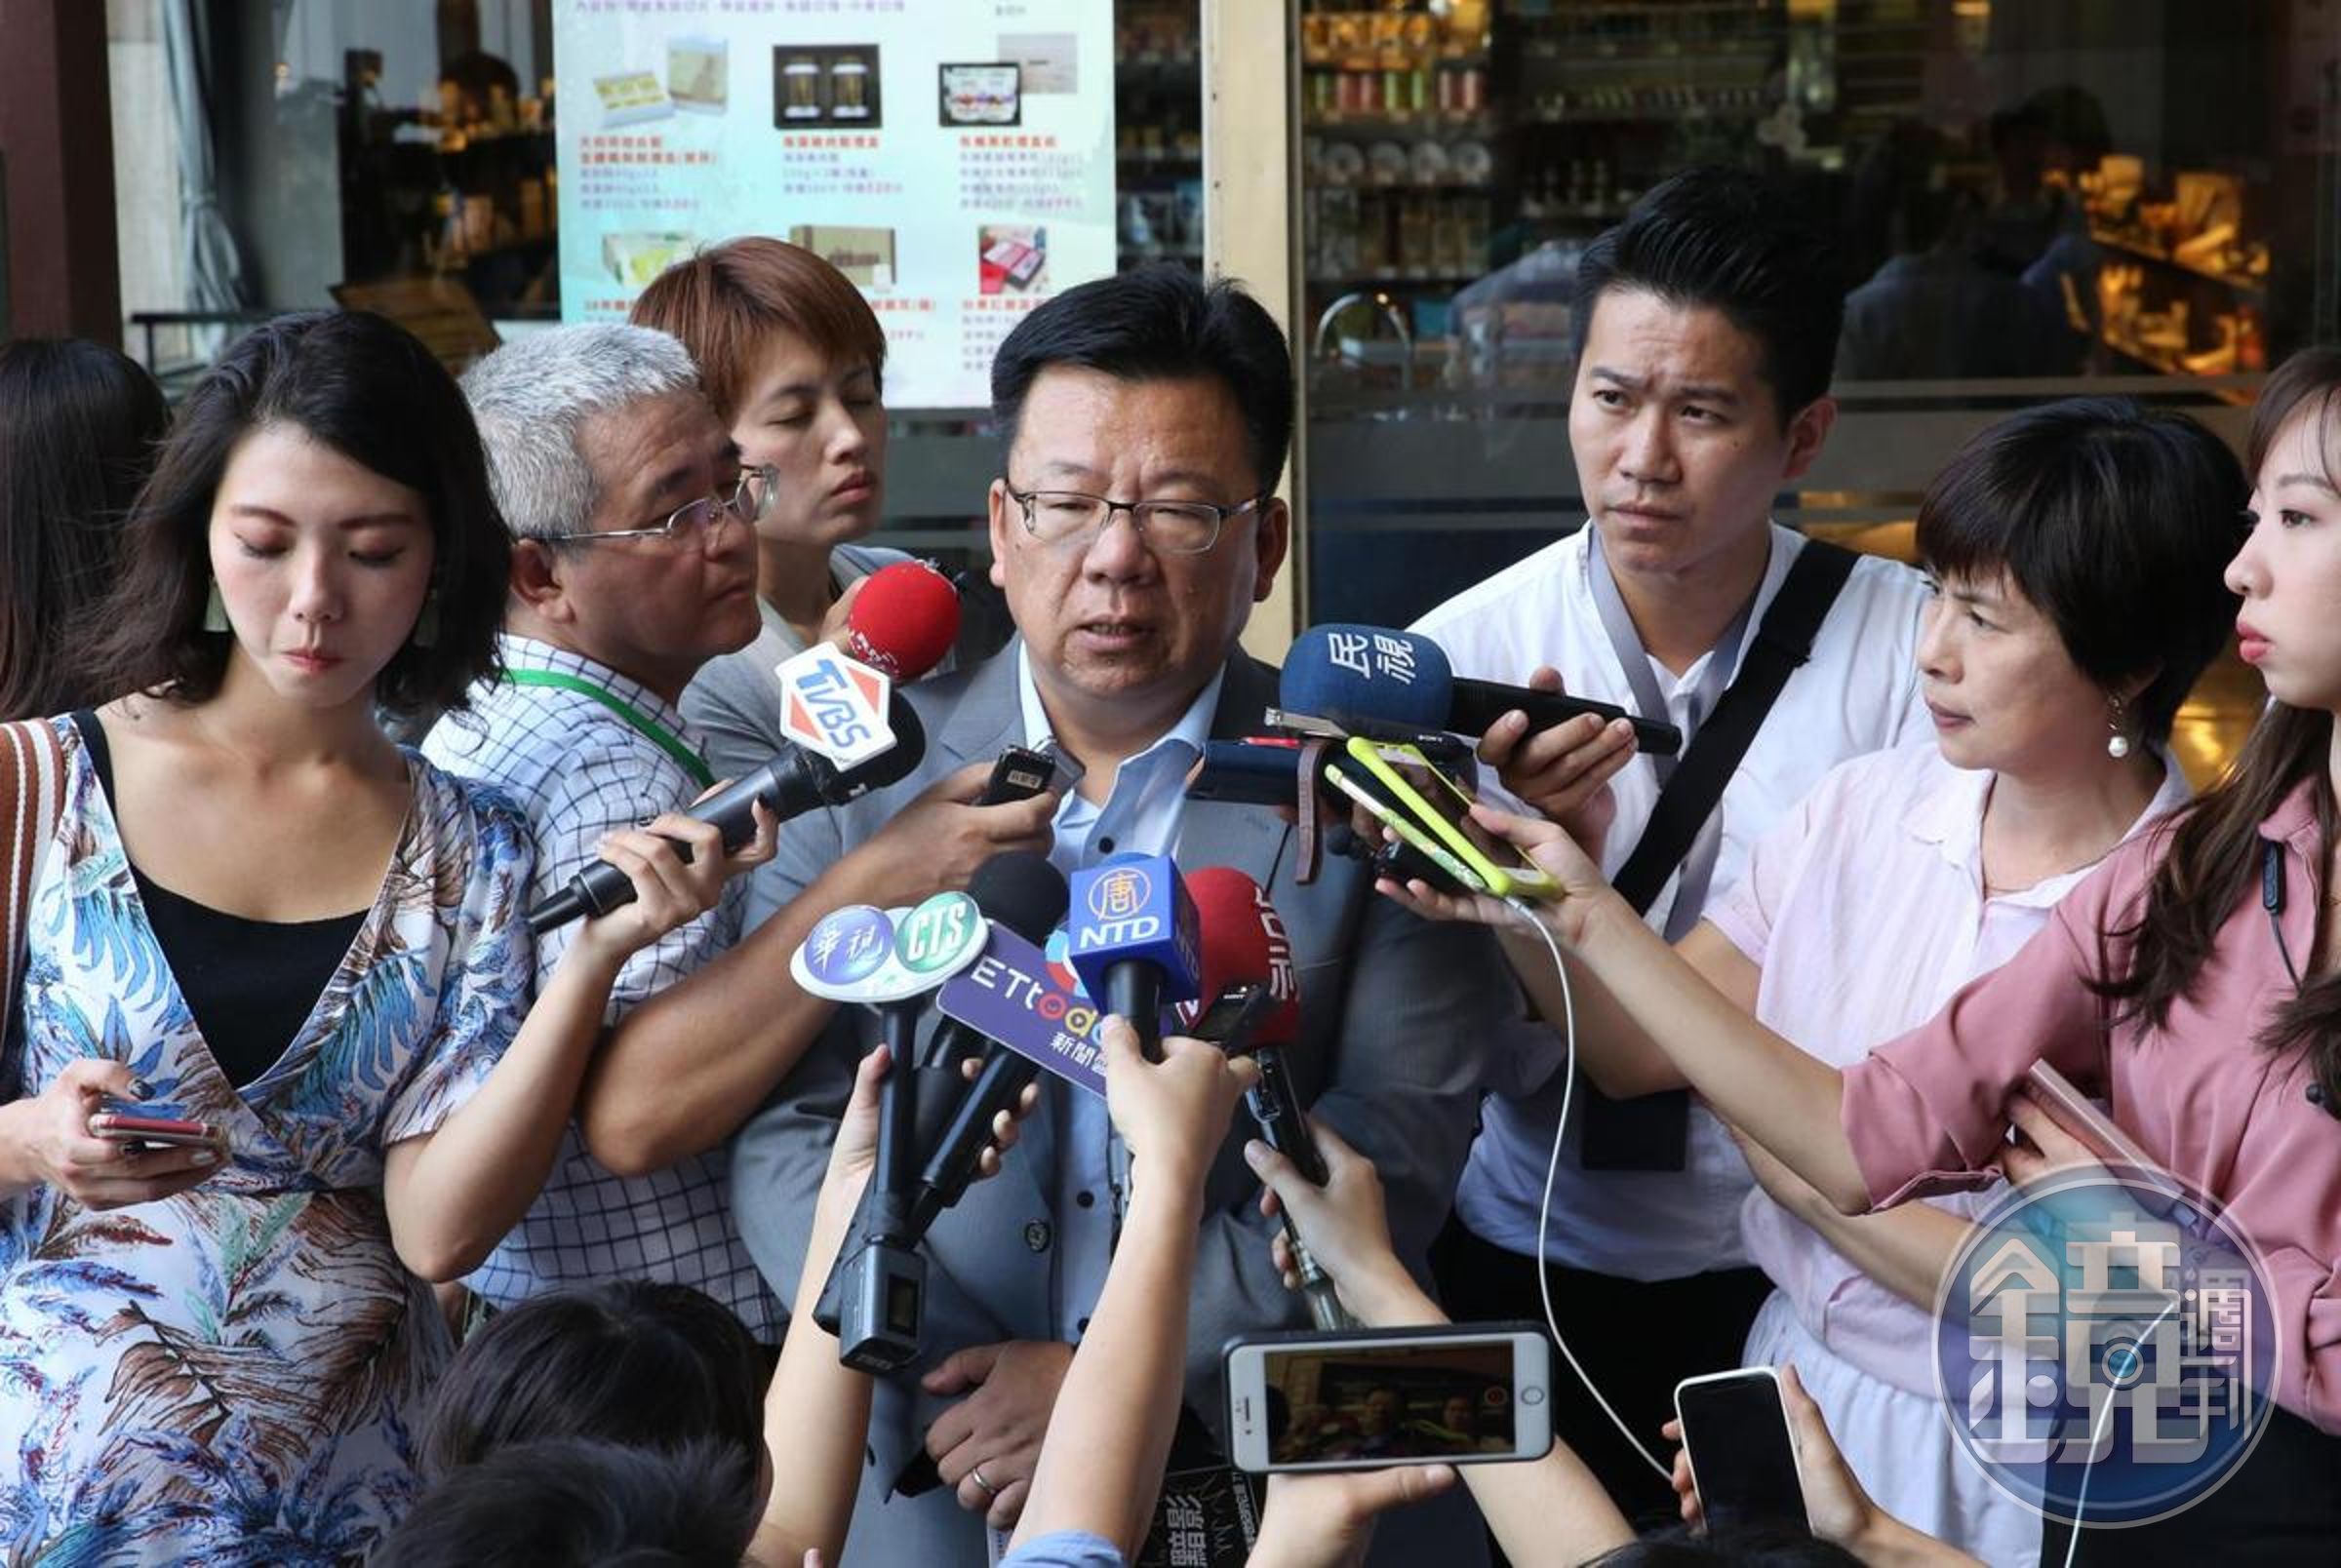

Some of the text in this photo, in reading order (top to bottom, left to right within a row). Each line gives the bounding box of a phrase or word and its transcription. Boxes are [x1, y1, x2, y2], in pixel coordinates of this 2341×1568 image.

[1328, 633, 1416, 685] 民視
[795, 657, 872, 749] TVBS
[1097, 872, 1141, 921] 唐
[906, 901, 968, 962] CTS
[1078, 915, 1160, 950] NTD
[971, 955, 1104, 1045] ETtod
